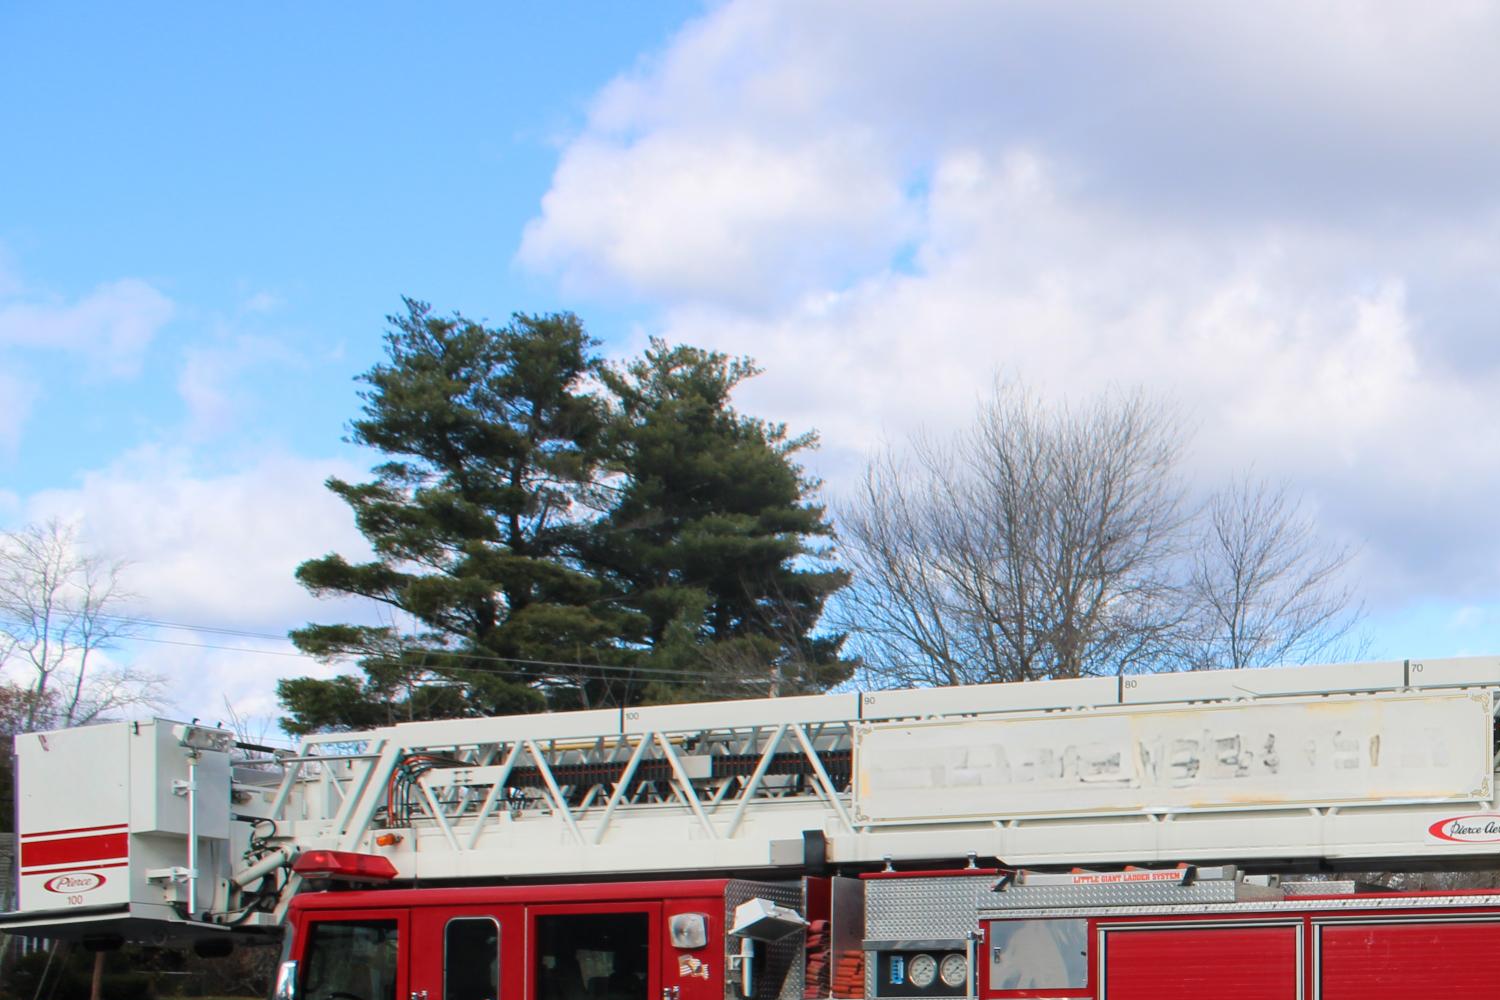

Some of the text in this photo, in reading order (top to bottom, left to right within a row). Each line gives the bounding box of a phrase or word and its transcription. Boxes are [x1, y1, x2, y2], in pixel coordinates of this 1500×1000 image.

[1410, 663, 1424, 673] 70
[1124, 679, 1138, 689] 80
[864, 696, 876, 705] 90
[625, 711, 640, 721] 100
[1449, 819, 1482, 838] Pierce
[67, 895, 83, 905] 100
